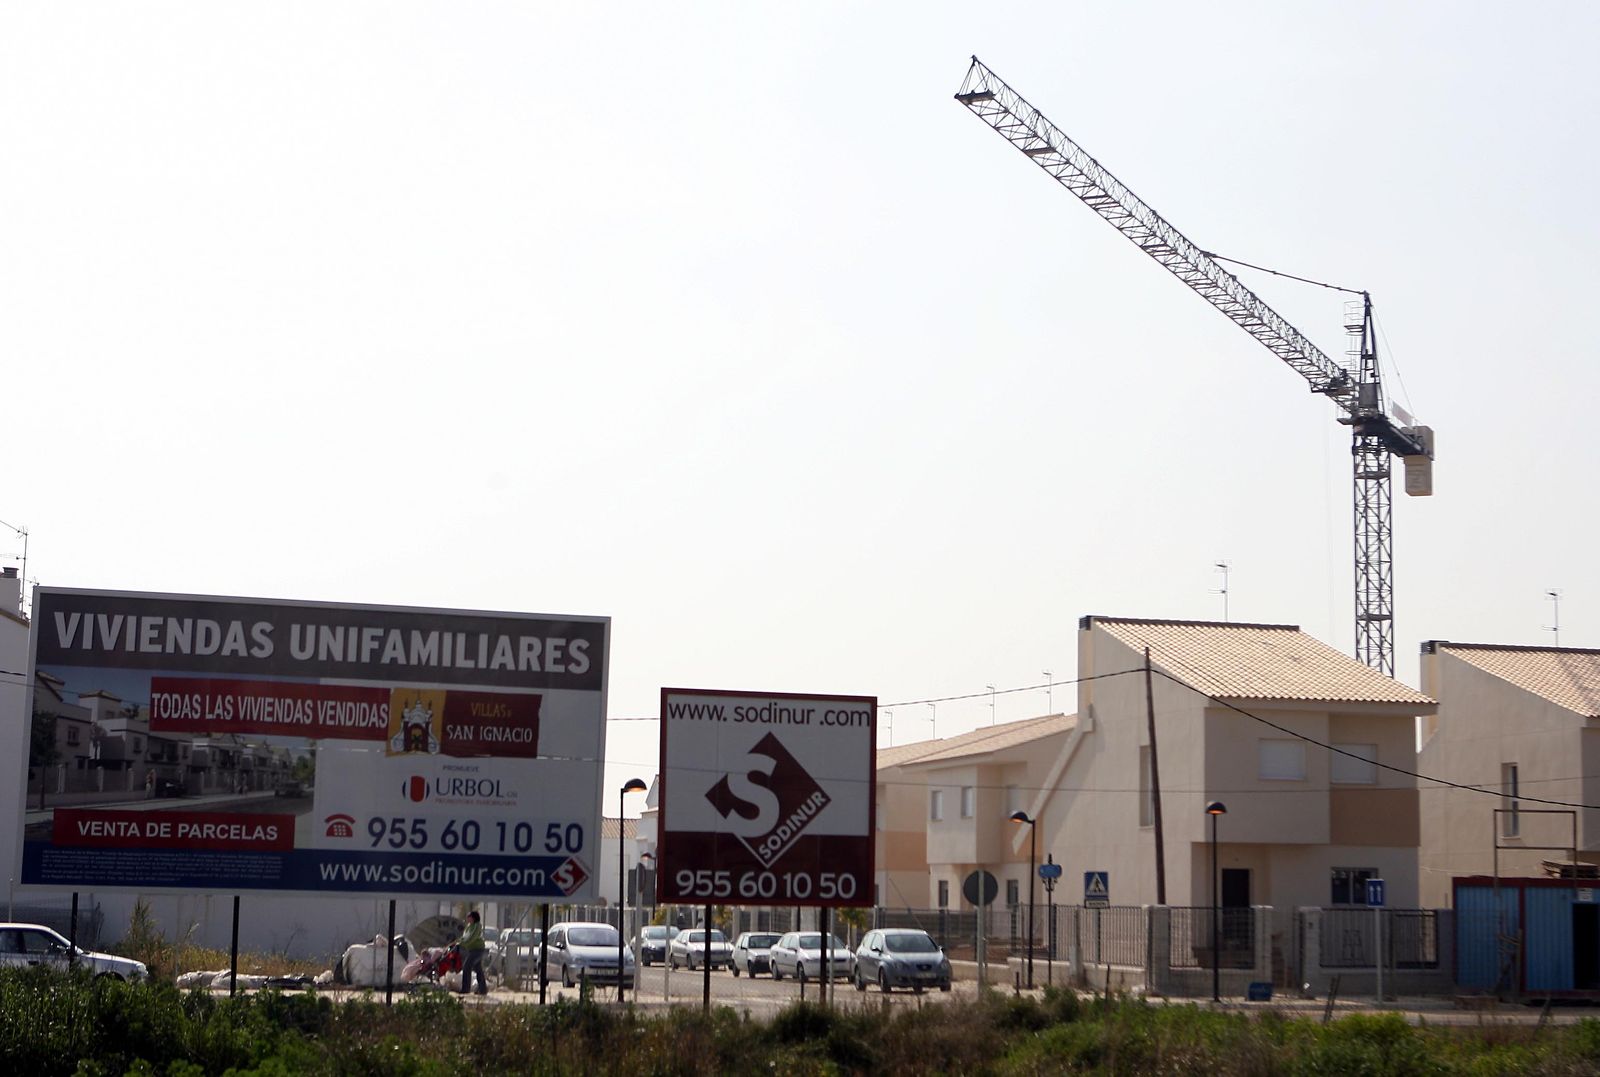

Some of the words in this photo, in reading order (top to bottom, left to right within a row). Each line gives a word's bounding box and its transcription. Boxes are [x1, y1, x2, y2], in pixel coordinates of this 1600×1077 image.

[54, 611, 274, 659] VIVIENDAS
[289, 623, 591, 675] UNIFAMILIARES
[152, 693, 201, 720] TODAS
[205, 694, 233, 721] LAS
[237, 695, 313, 725] VIVIENDAS
[317, 700, 389, 729] VENDIDAS
[471, 702, 506, 718] VILLAS
[446, 724, 474, 741] SAN
[479, 726, 533, 743] IGNACIO
[435, 777, 504, 798] URBOL
[77, 820, 141, 838] VENTA
[146, 822, 171, 839] DE
[178, 823, 278, 841] PARCELAS
[367, 816, 428, 849] 955
[441, 819, 480, 851] 60
[496, 821, 533, 853] 10
[544, 822, 584, 854] 50
[758, 790, 828, 860] SODINUR
[319, 861, 546, 887] www.sodinur.com
[676, 869, 732, 897] 955
[739, 871, 777, 898] 60
[783, 872, 812, 899] 10
[819, 873, 857, 900] 50
